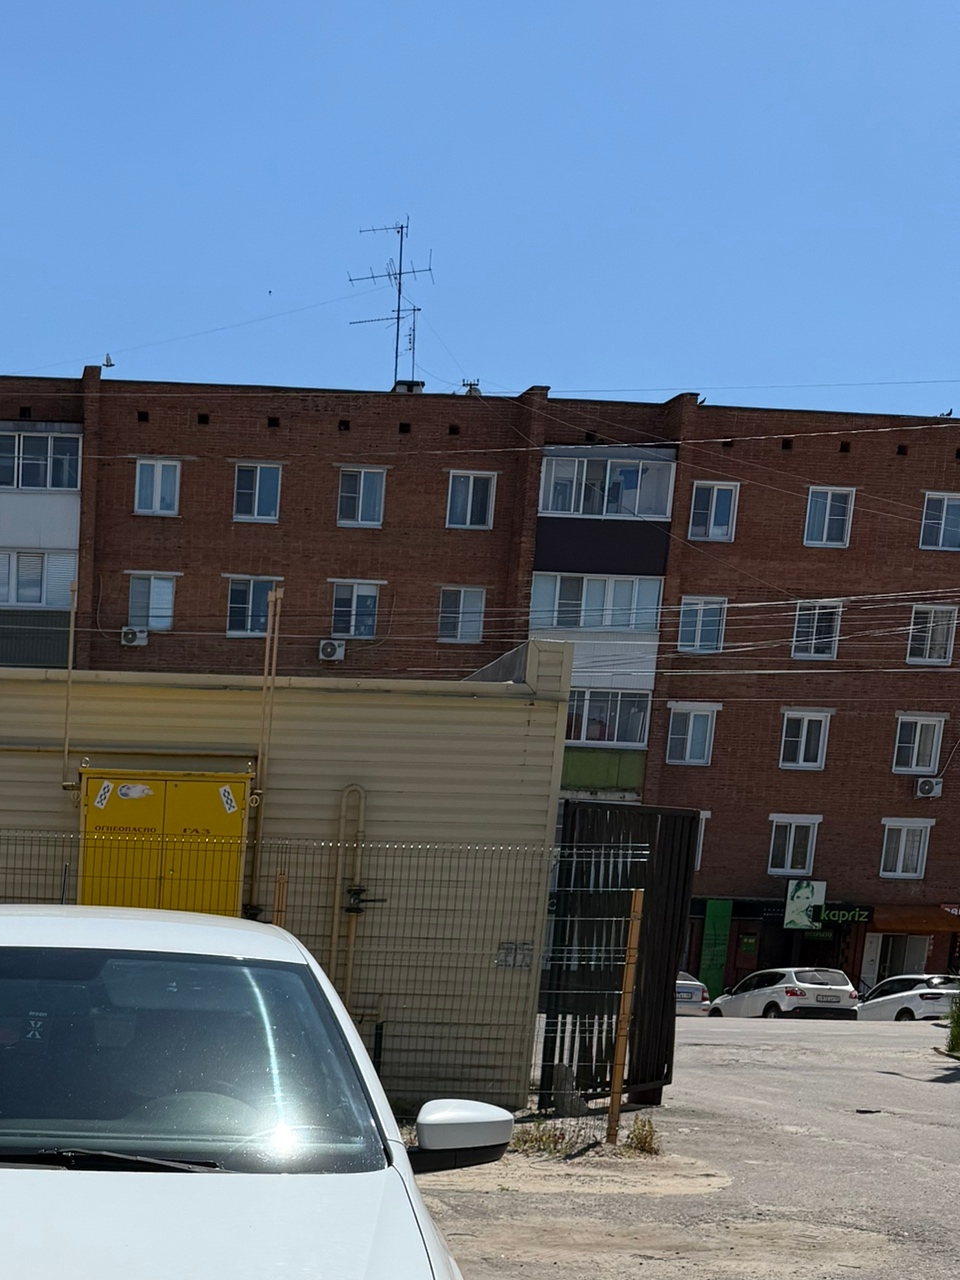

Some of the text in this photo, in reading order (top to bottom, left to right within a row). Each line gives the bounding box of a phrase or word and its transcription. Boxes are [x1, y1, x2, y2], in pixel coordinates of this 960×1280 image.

[94, 825, 157, 833] ОГНЕОПАСНО
[182, 827, 211, 835] ГАЗ
[820, 904, 869, 923] kapriz
